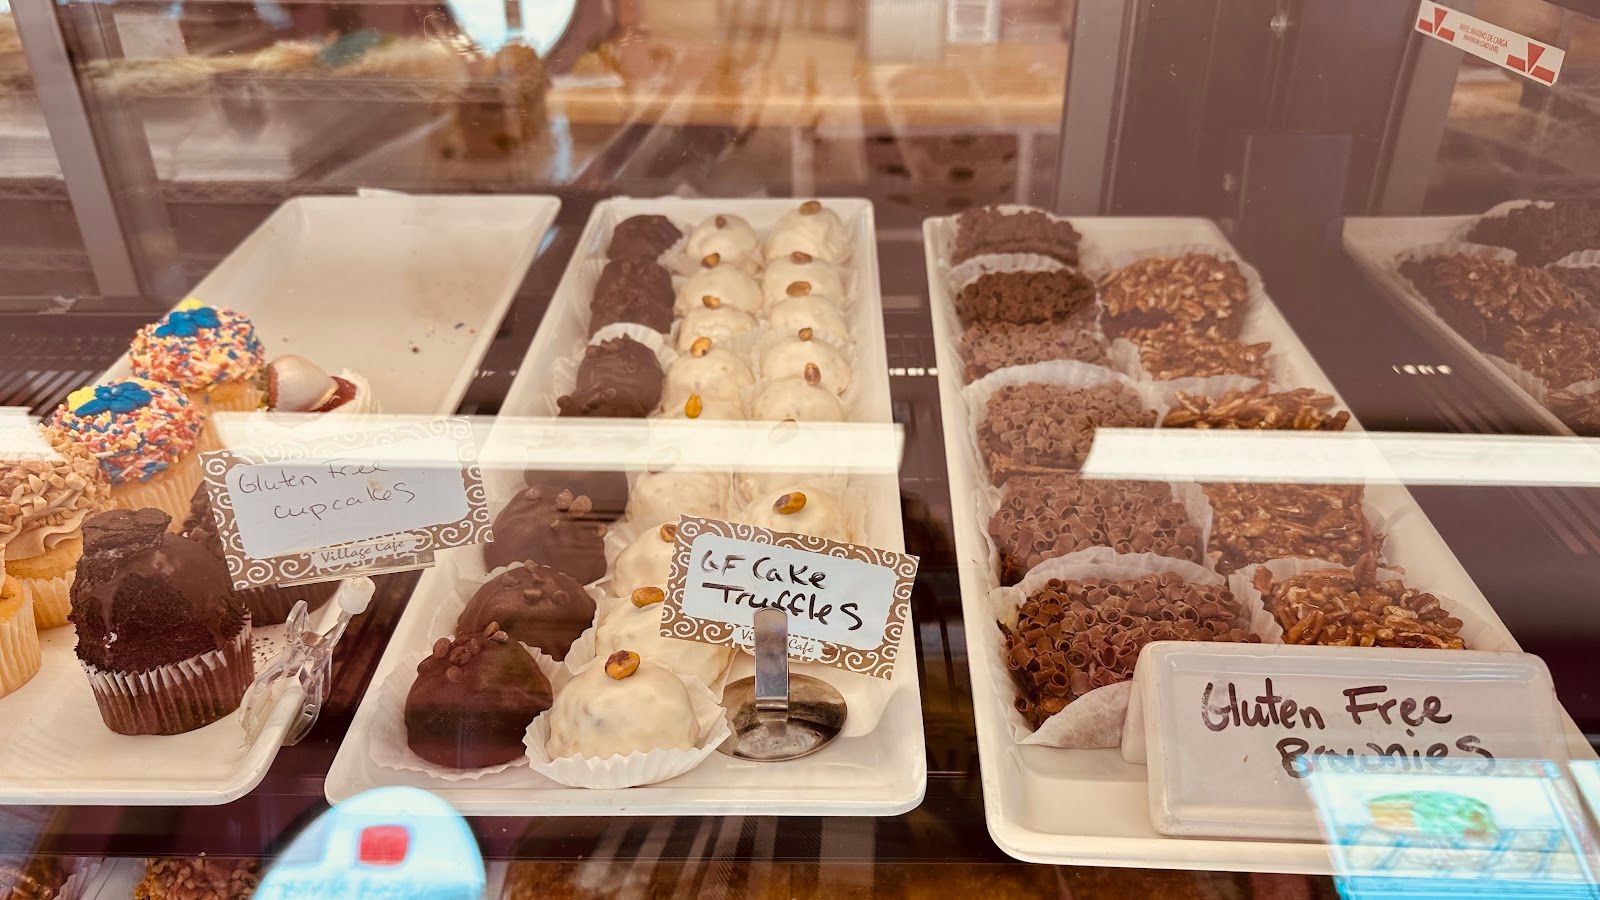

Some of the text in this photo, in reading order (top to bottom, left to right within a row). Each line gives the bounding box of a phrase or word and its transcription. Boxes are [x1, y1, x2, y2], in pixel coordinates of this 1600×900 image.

[238, 458, 390, 494] Gluten Free
[321, 546, 372, 564] Village
[700, 549, 826, 590] GF Cake
[1201, 678, 1453, 732] Gluten Free
[1275, 728, 1497, 779] Brownies
